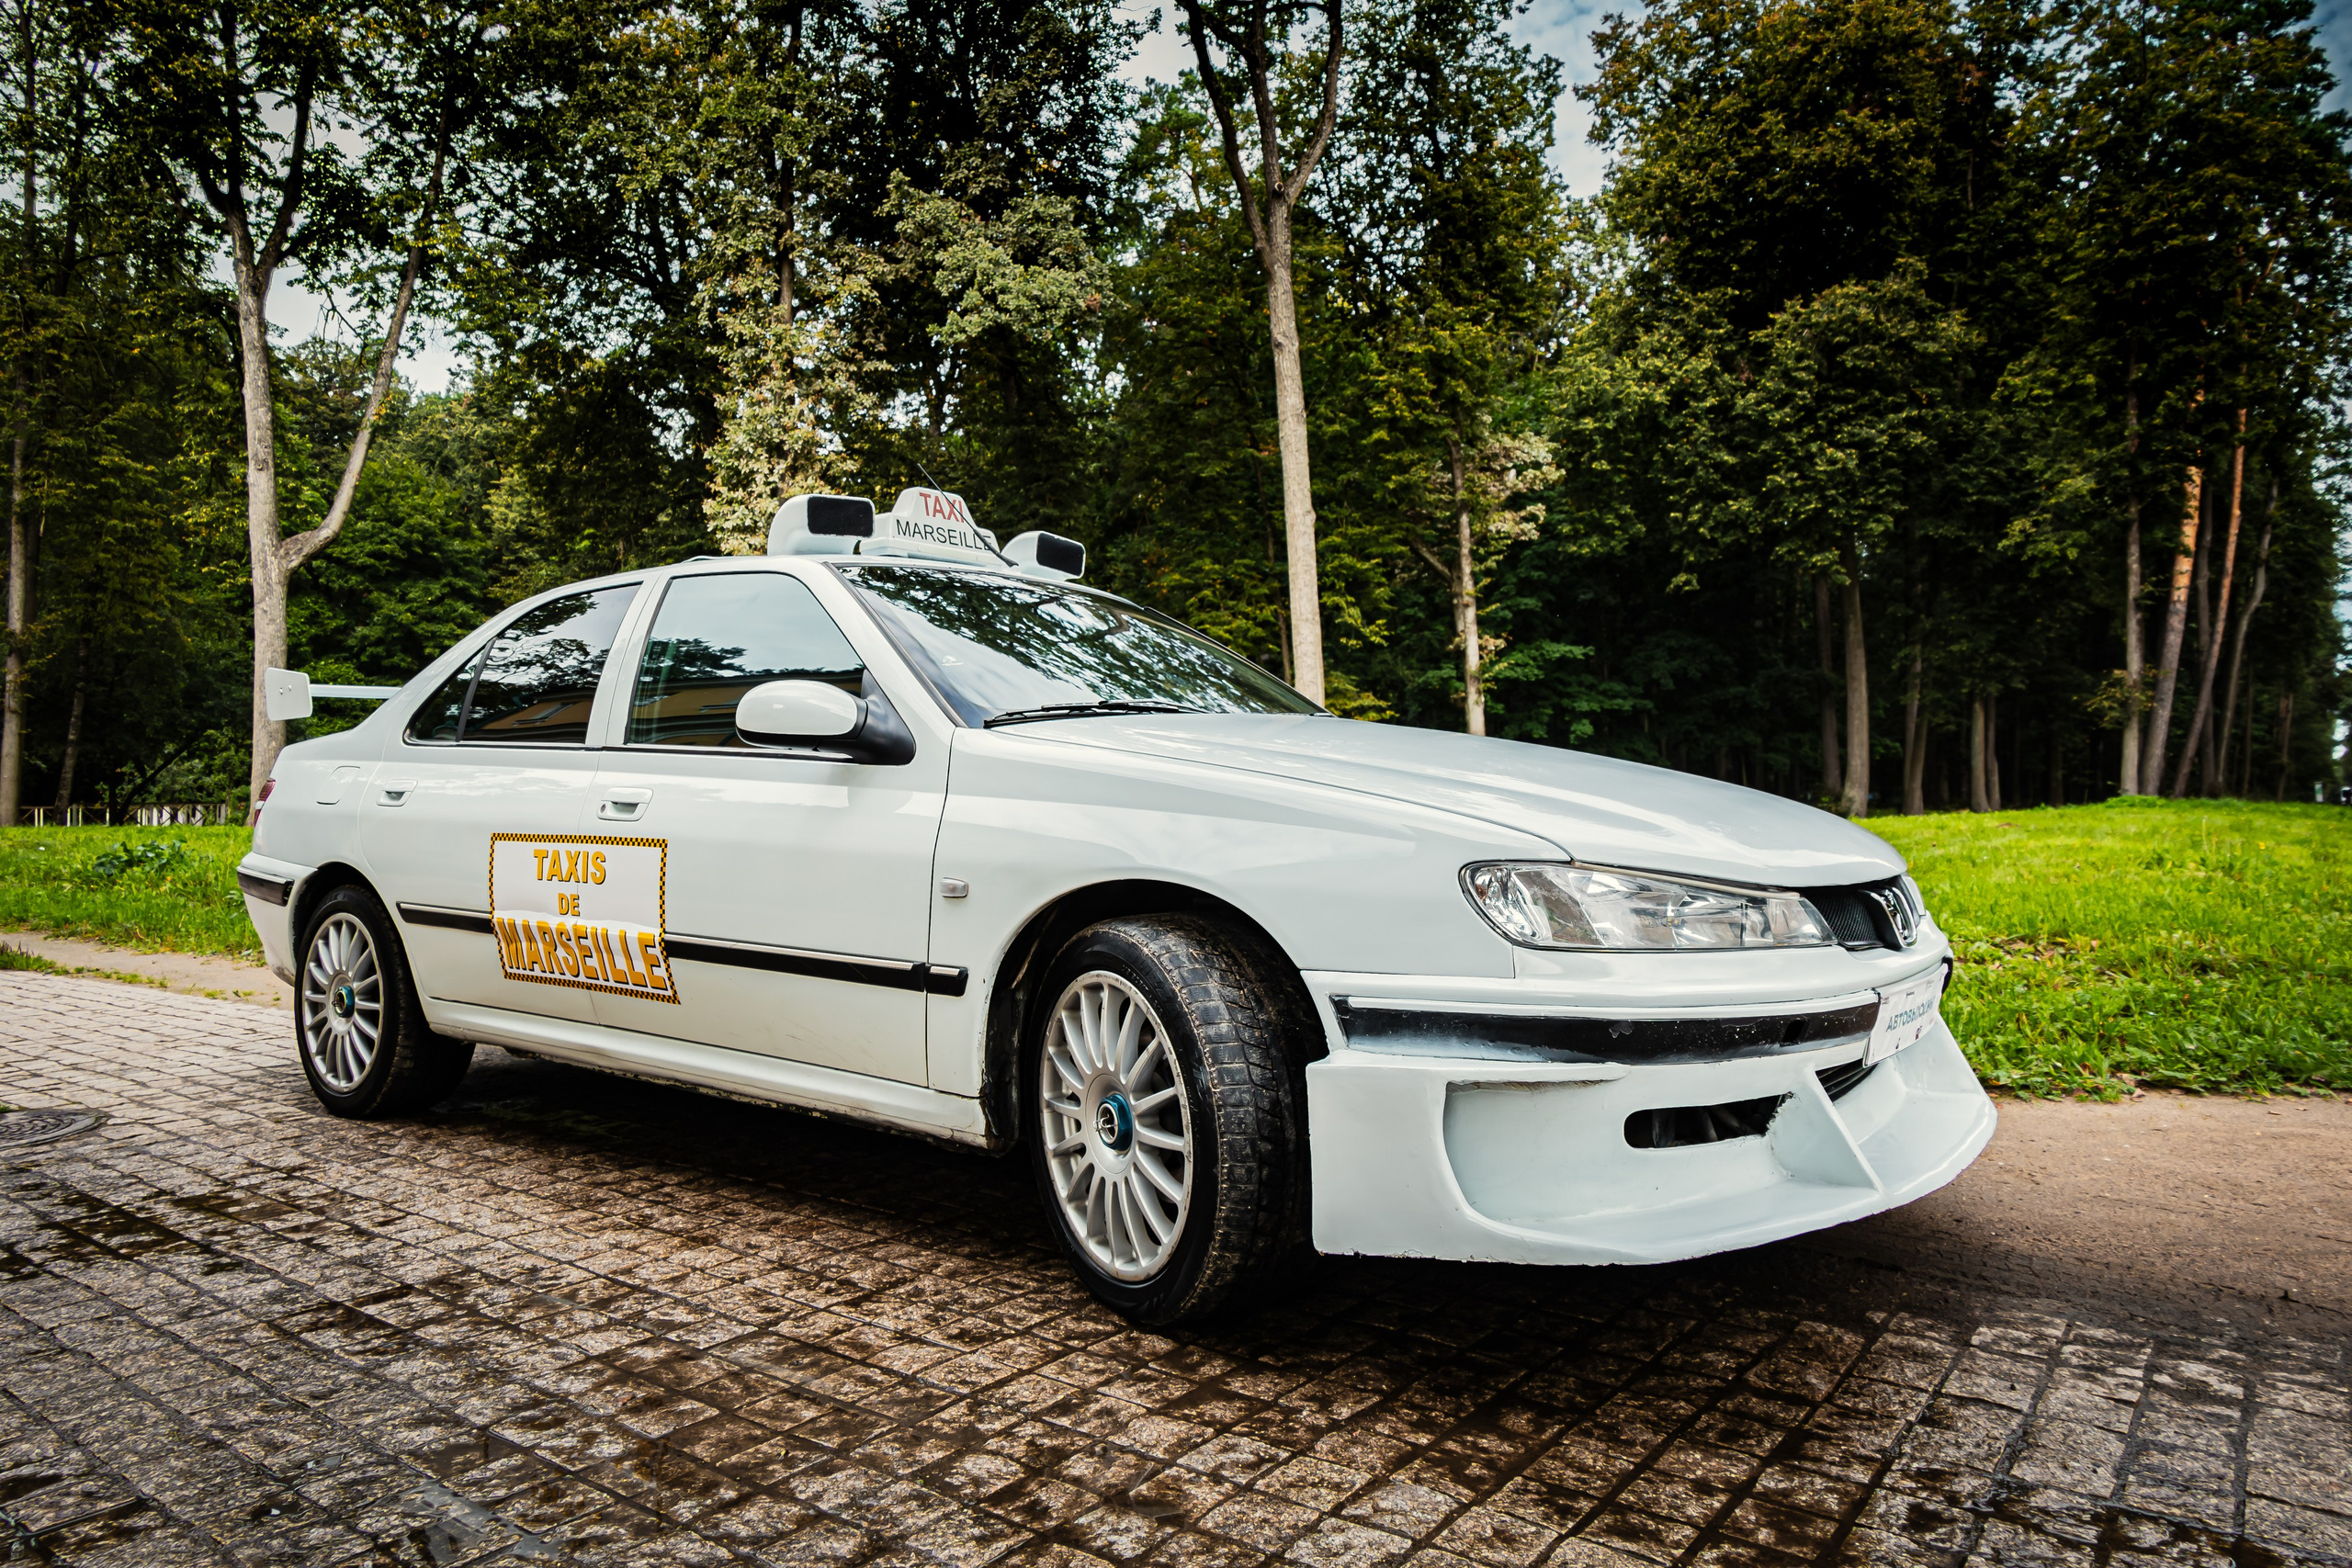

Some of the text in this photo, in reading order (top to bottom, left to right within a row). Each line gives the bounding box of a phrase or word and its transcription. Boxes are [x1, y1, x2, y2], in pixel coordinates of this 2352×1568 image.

[919, 491, 965, 523] TAXI
[533, 849, 606, 885] TAXIS
[558, 893, 581, 916] DE
[496, 917, 668, 991] MARSEILLE
